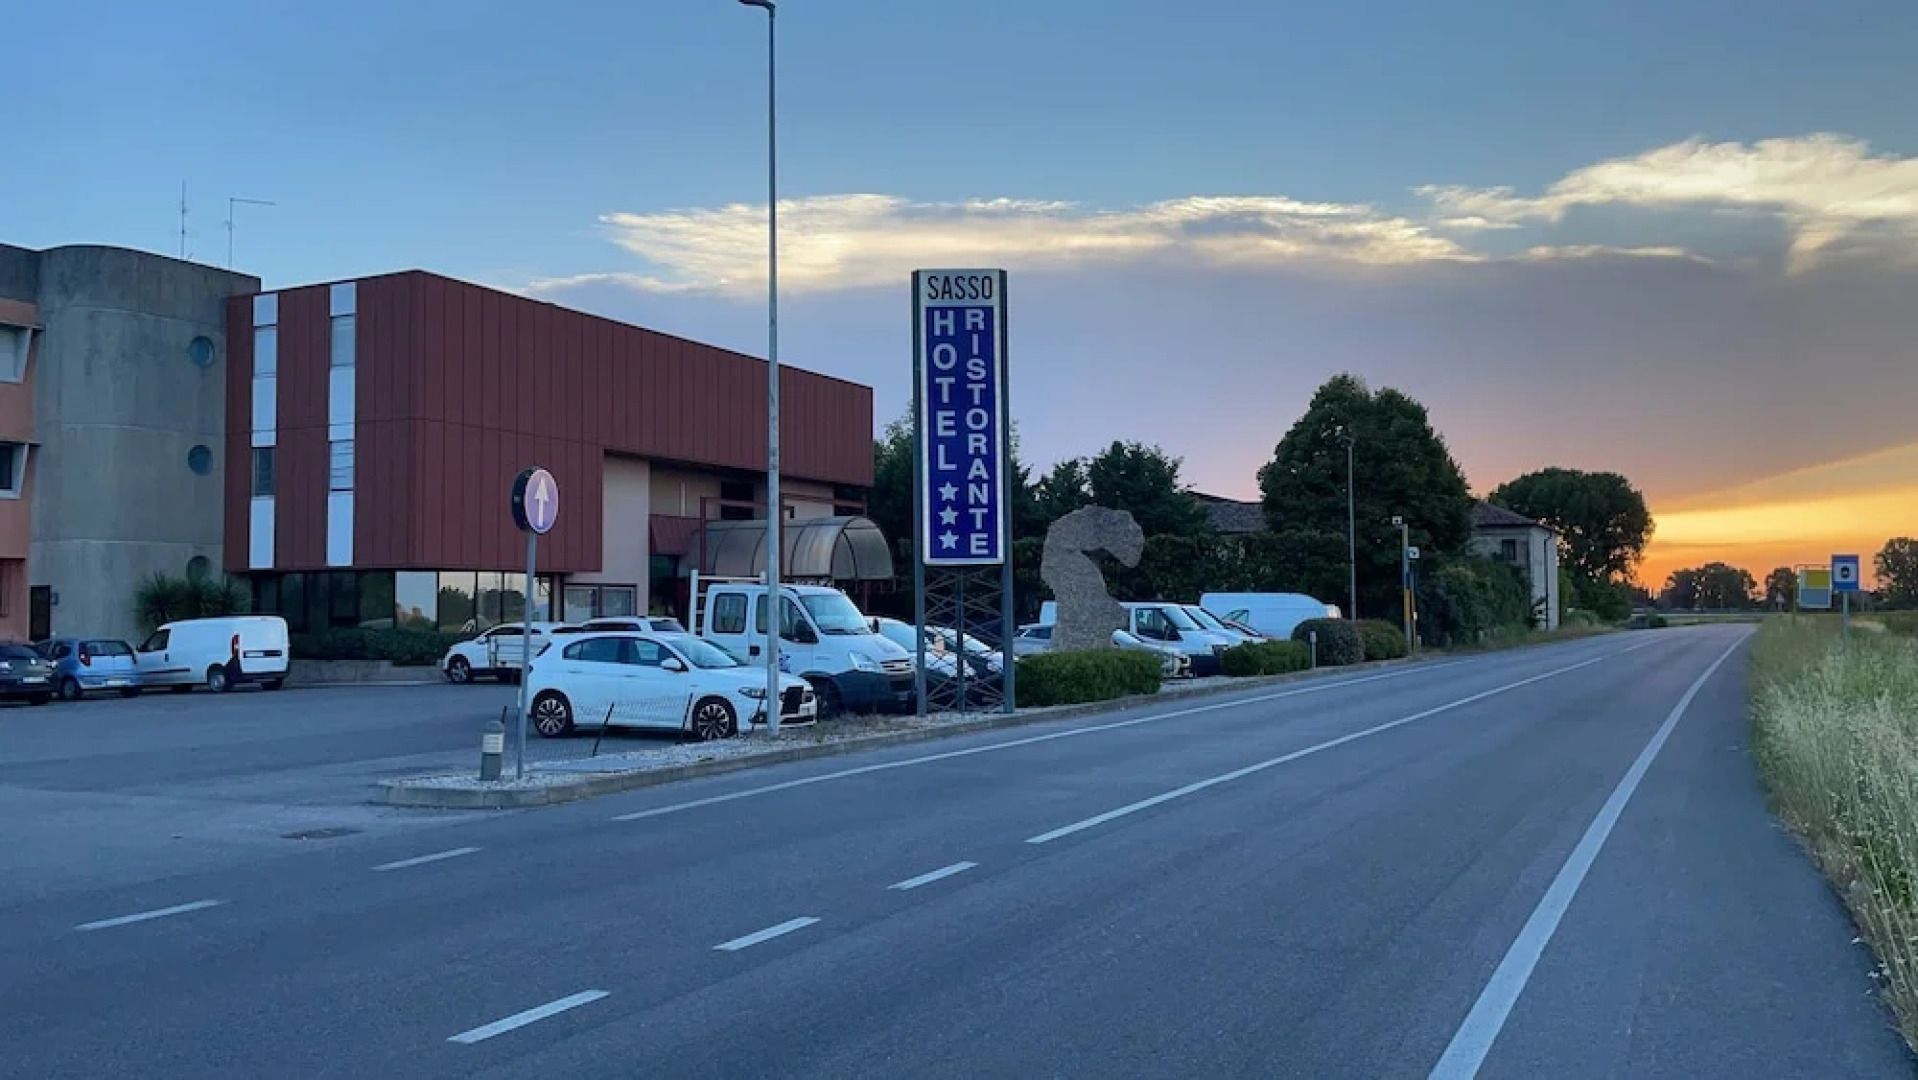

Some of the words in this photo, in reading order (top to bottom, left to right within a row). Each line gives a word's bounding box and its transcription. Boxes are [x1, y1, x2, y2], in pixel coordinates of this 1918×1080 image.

[927, 275, 993, 300] SASSO
[933, 310, 957, 471] HOTEL
[964, 308, 990, 555] RISTORANTE
